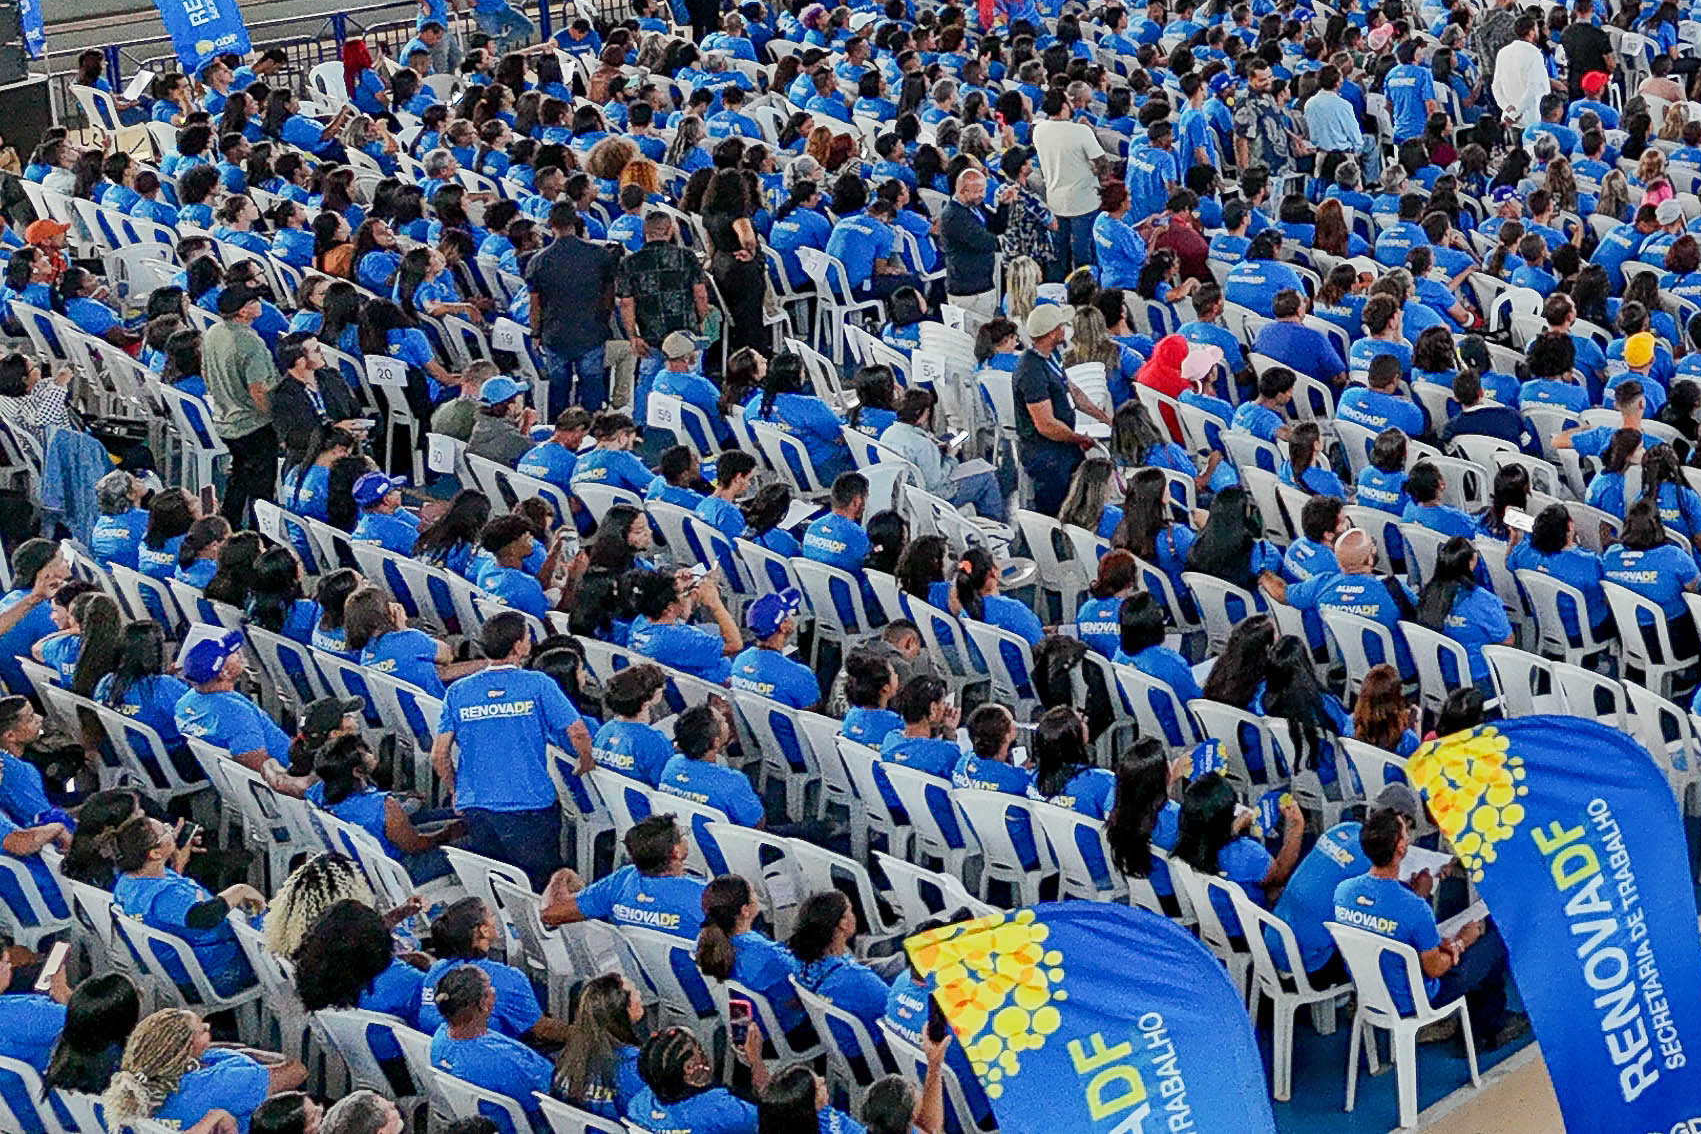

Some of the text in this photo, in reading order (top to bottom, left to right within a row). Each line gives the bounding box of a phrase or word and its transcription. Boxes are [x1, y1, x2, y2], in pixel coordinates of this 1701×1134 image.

[377, 368, 392, 380] 20
[1079, 622, 1121, 635] RENOVA
[459, 700, 532, 720] RENOVADF
[1587, 798, 1687, 1070] SECRETARIA DE TRABALHO
[1530, 820, 1660, 1103] RENOVADF
